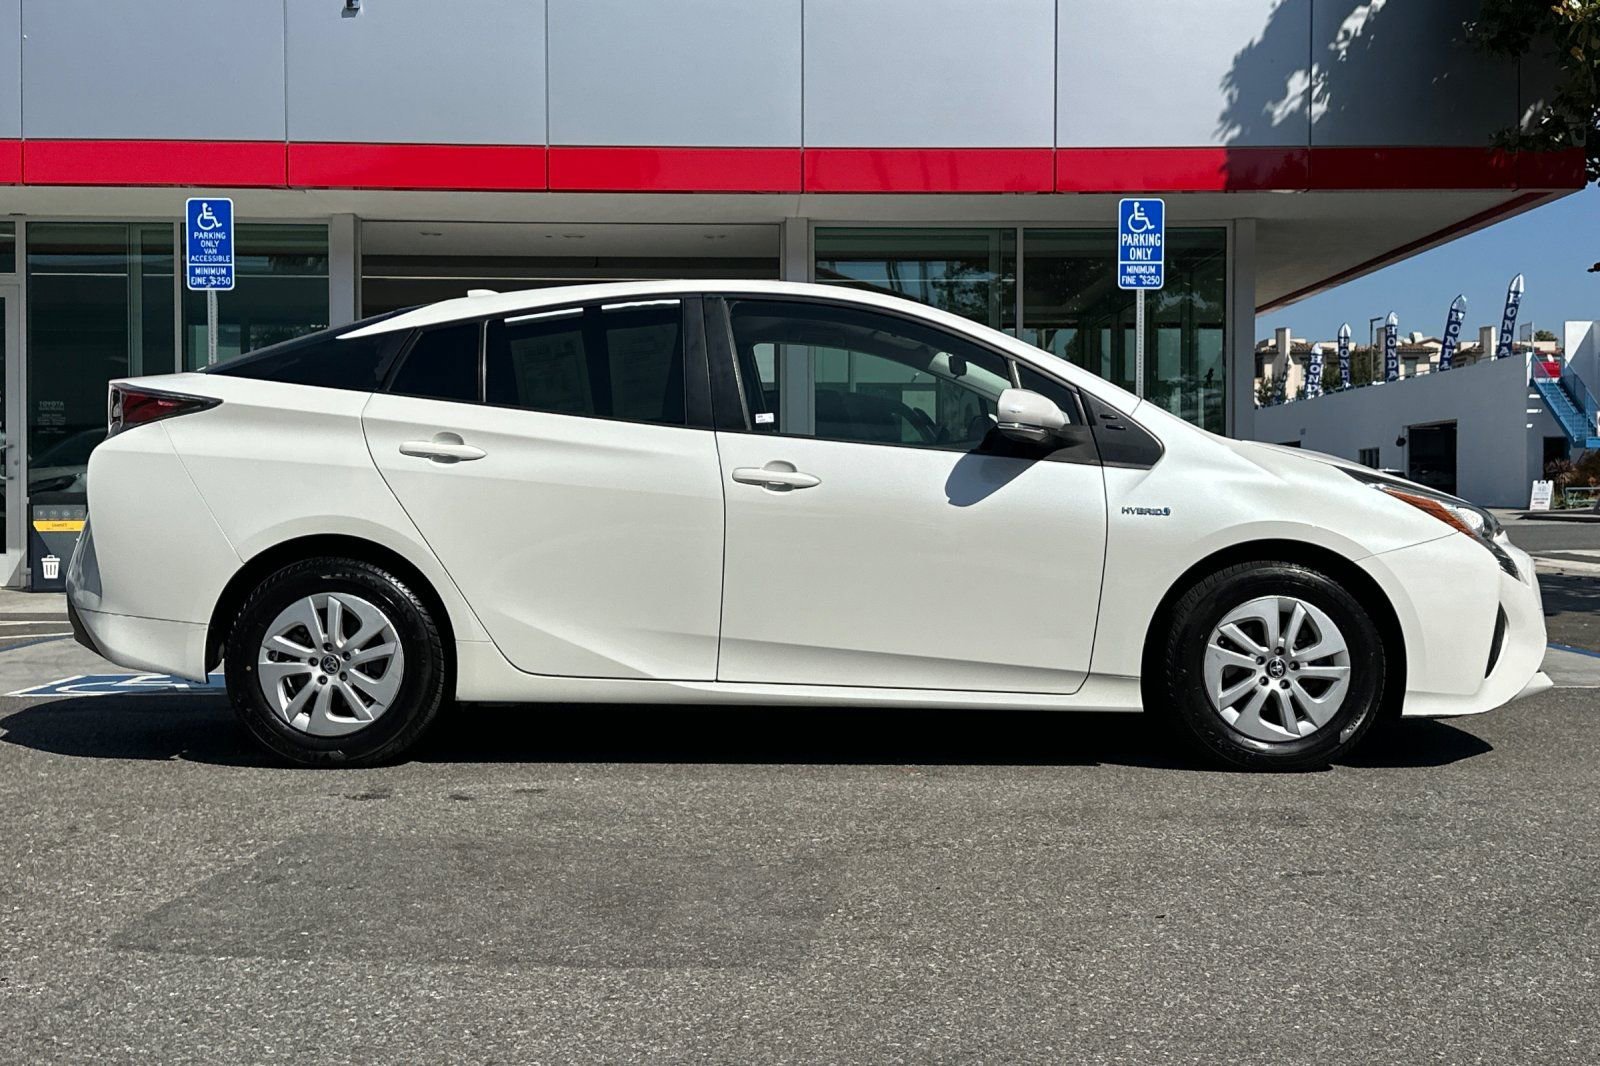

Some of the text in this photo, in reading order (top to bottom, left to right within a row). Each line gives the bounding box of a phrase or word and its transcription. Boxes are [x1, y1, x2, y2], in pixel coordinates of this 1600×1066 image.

[1122, 233, 1160, 246] PARKING
[1129, 247, 1153, 260] ONLY
[1126, 265, 1155, 274] MINIMUM
[191, 276, 230, 285] FINE $250
[1122, 275, 1160, 285] FINE $250
[1499, 293, 1521, 356] HONDA
[1440, 310, 1464, 369] HONDA
[1386, 326, 1398, 379] HONDA
[1121, 506, 1162, 516] HYBRID
